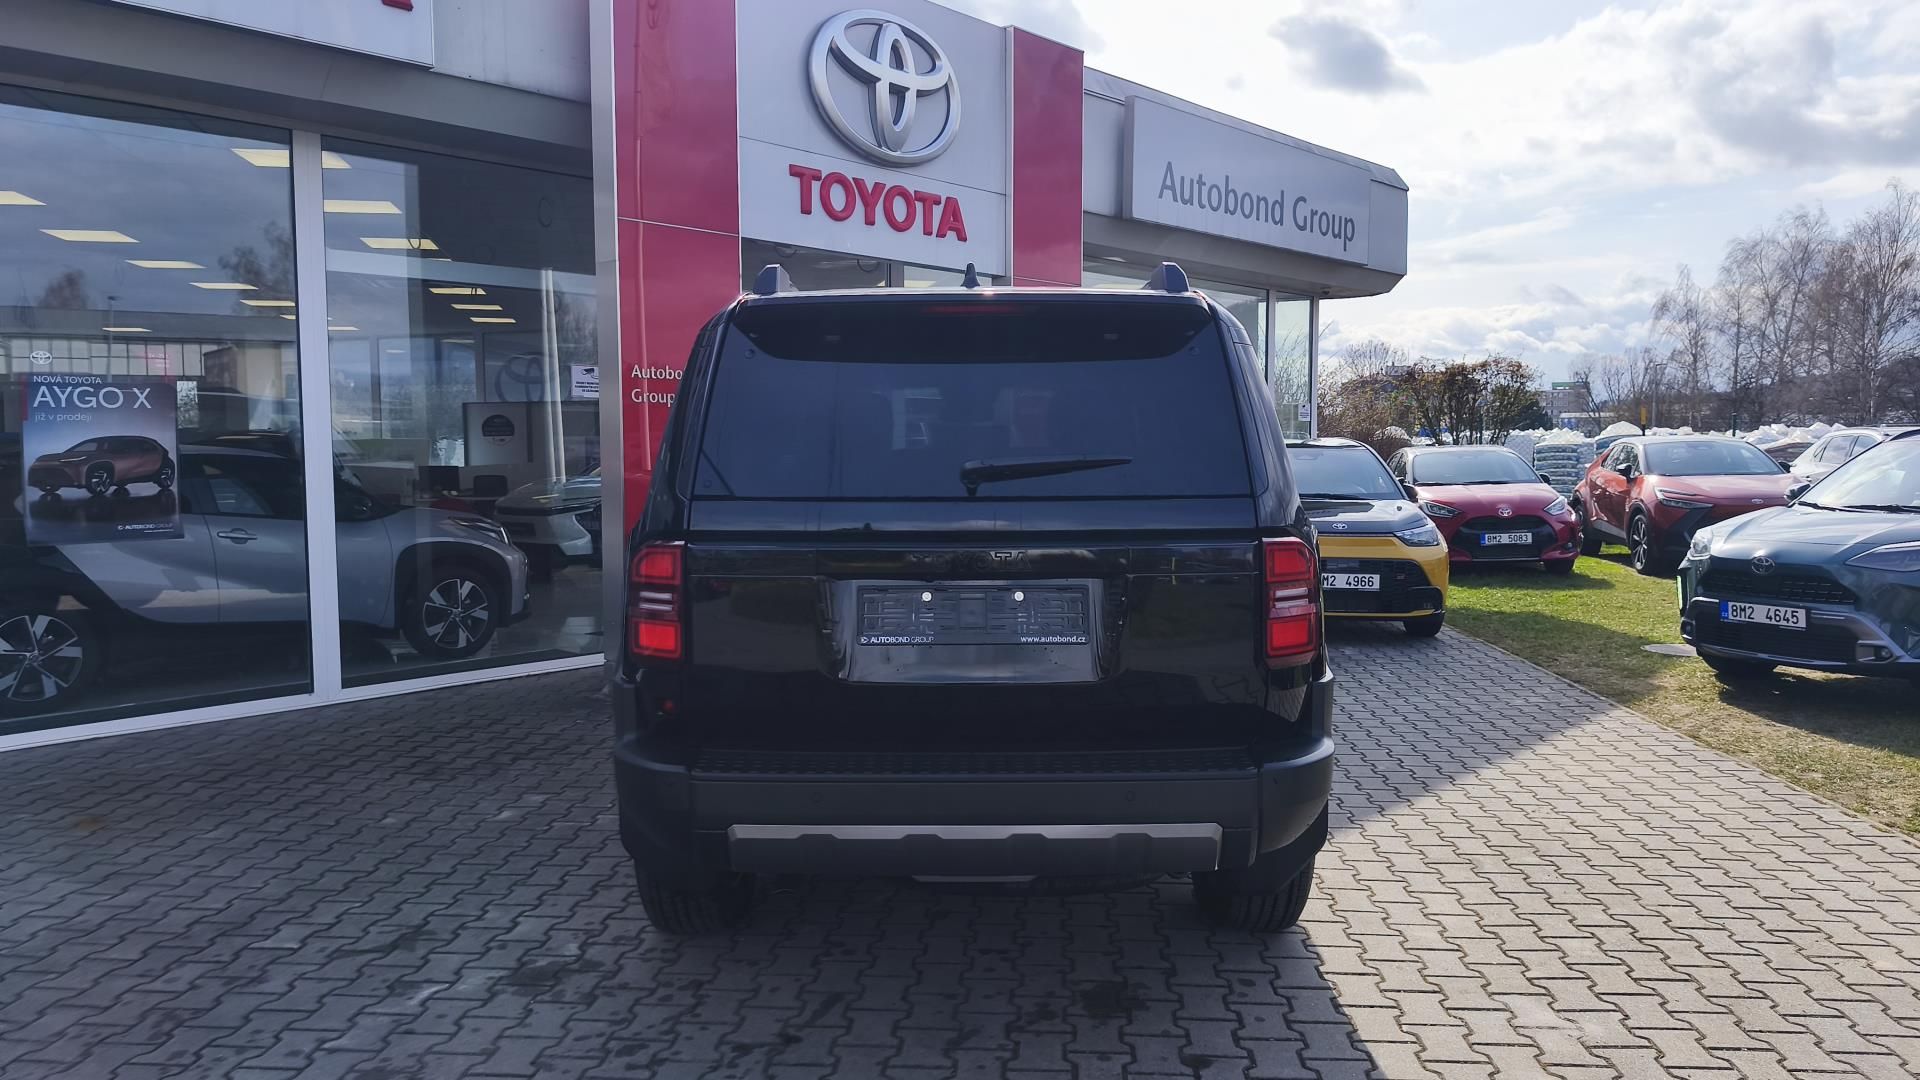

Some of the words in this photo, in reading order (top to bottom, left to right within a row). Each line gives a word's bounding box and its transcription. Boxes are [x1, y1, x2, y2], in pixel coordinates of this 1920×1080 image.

[788, 163, 968, 242] TOYOTA
[1157, 160, 1285, 227] Autobond
[1292, 195, 1356, 252] Group
[33, 374, 62, 384] NOVÁ
[64, 375, 102, 384] TOYOTA
[631, 364, 683, 380] Autobo
[32, 385, 124, 409] AYGO
[132, 387, 152, 409] X
[631, 388, 676, 408] Group
[34, 412, 46, 422] již
[56, 412, 92, 422] prodeji
[1487, 535, 1502, 543] 8M2
[1508, 534, 1528, 543] 5083
[1322, 574, 1337, 587] M2
[1345, 575, 1375, 588] 4966
[1731, 604, 1755, 620] 8M2
[1765, 607, 1799, 625] 4645
[1020, 635, 1086, 643] www.autobond.cz
